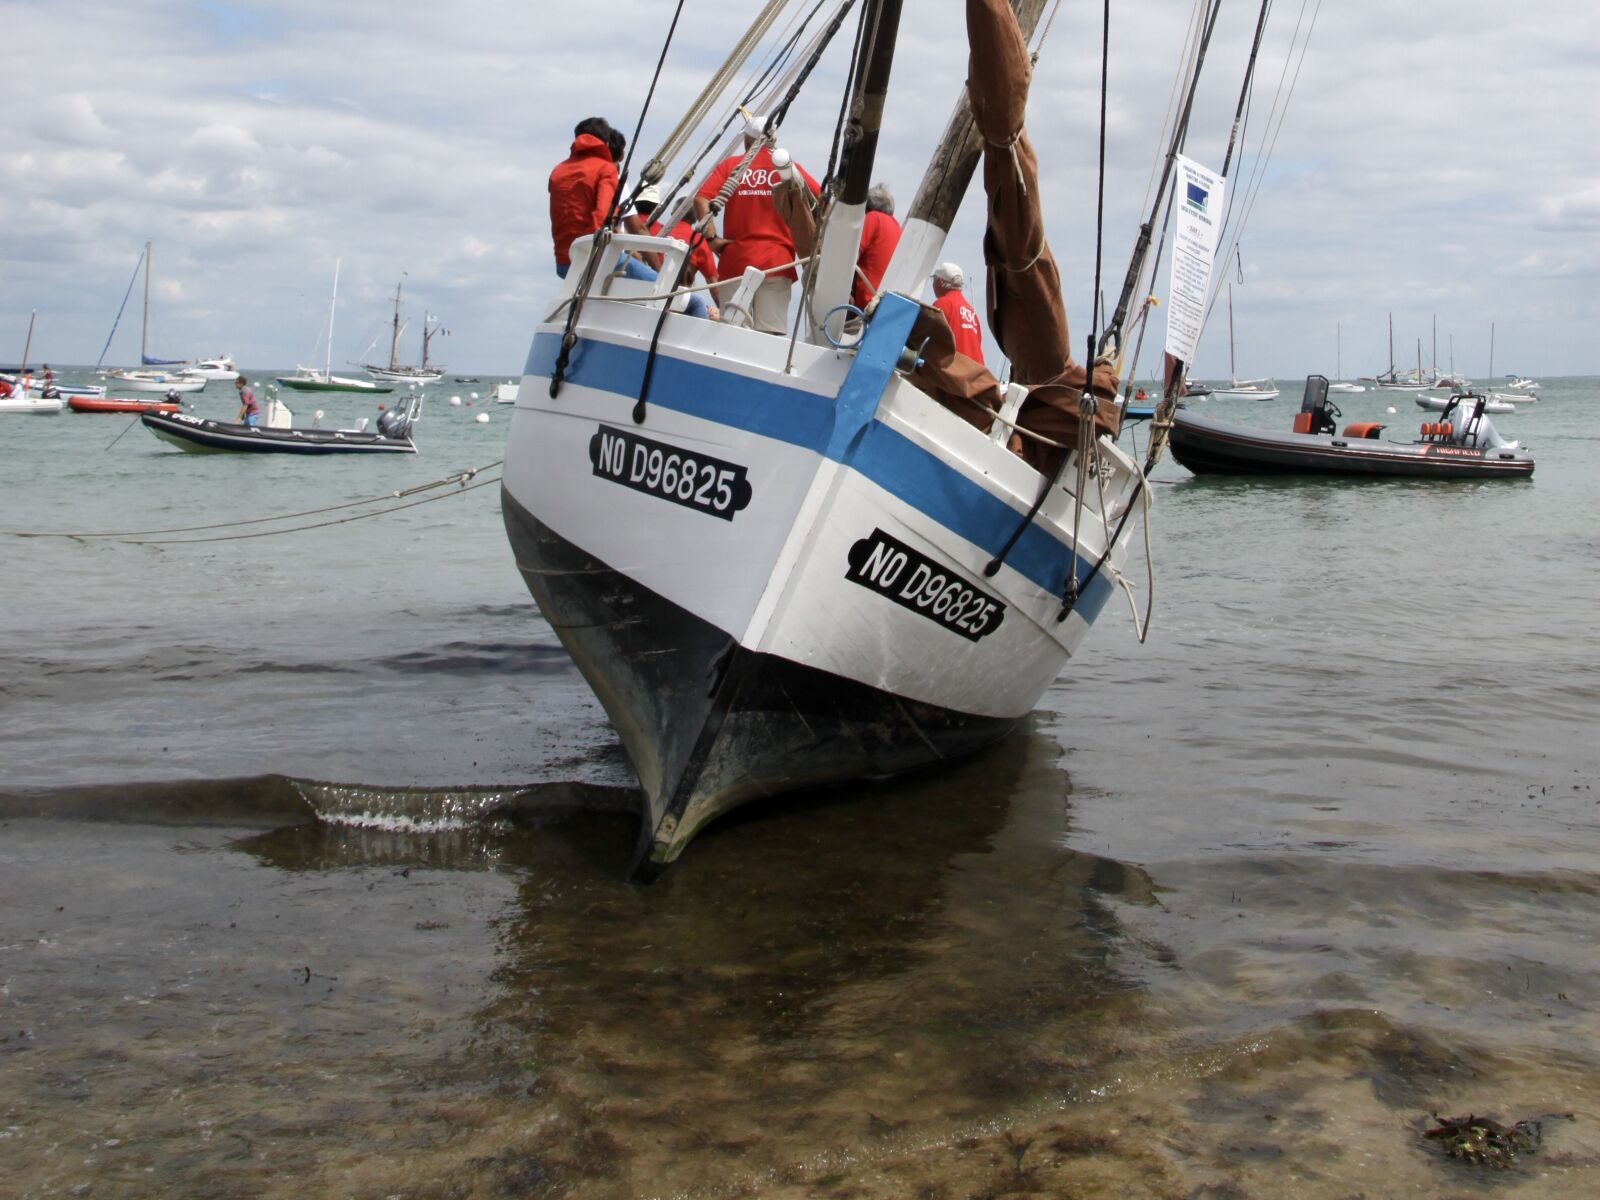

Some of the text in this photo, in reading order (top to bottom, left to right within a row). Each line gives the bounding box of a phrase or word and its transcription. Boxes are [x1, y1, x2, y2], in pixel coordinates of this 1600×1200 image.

[599, 433, 736, 511] NO D96825
[859, 541, 997, 634] NO D96825
